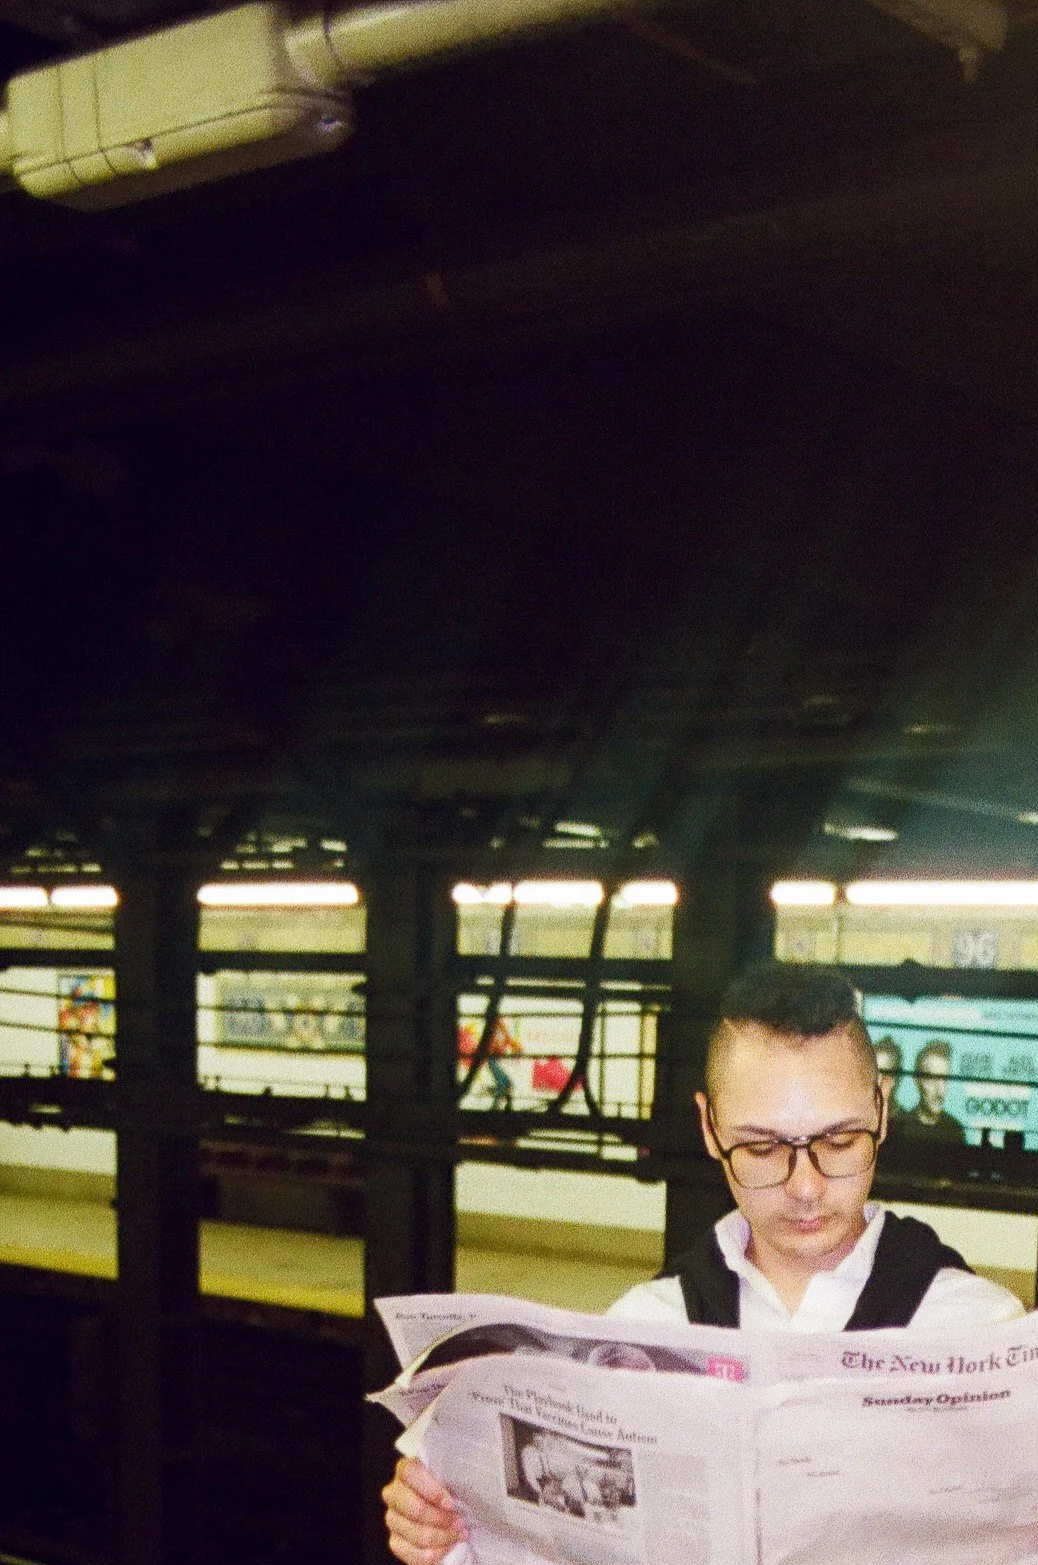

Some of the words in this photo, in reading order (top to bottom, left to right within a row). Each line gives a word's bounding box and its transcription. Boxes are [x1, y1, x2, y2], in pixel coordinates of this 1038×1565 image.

[966, 1098, 1030, 1118] GODOT
[841, 1350, 886, 1372] The
[889, 1354, 941, 1375] New
[945, 1353, 1001, 1376] York
[503, 1384, 525, 1398] The
[525, 1388, 574, 1414] Playbook
[604, 1412, 619, 1425] to
[861, 1394, 934, 1408] Sunday
[935, 1387, 1012, 1407] Opinion
[505, 1397, 533, 1415] That
[535, 1404, 579, 1430] Vaccines
[580, 1420, 614, 1438] Cause
[616, 1427, 658, 1444] Autism
